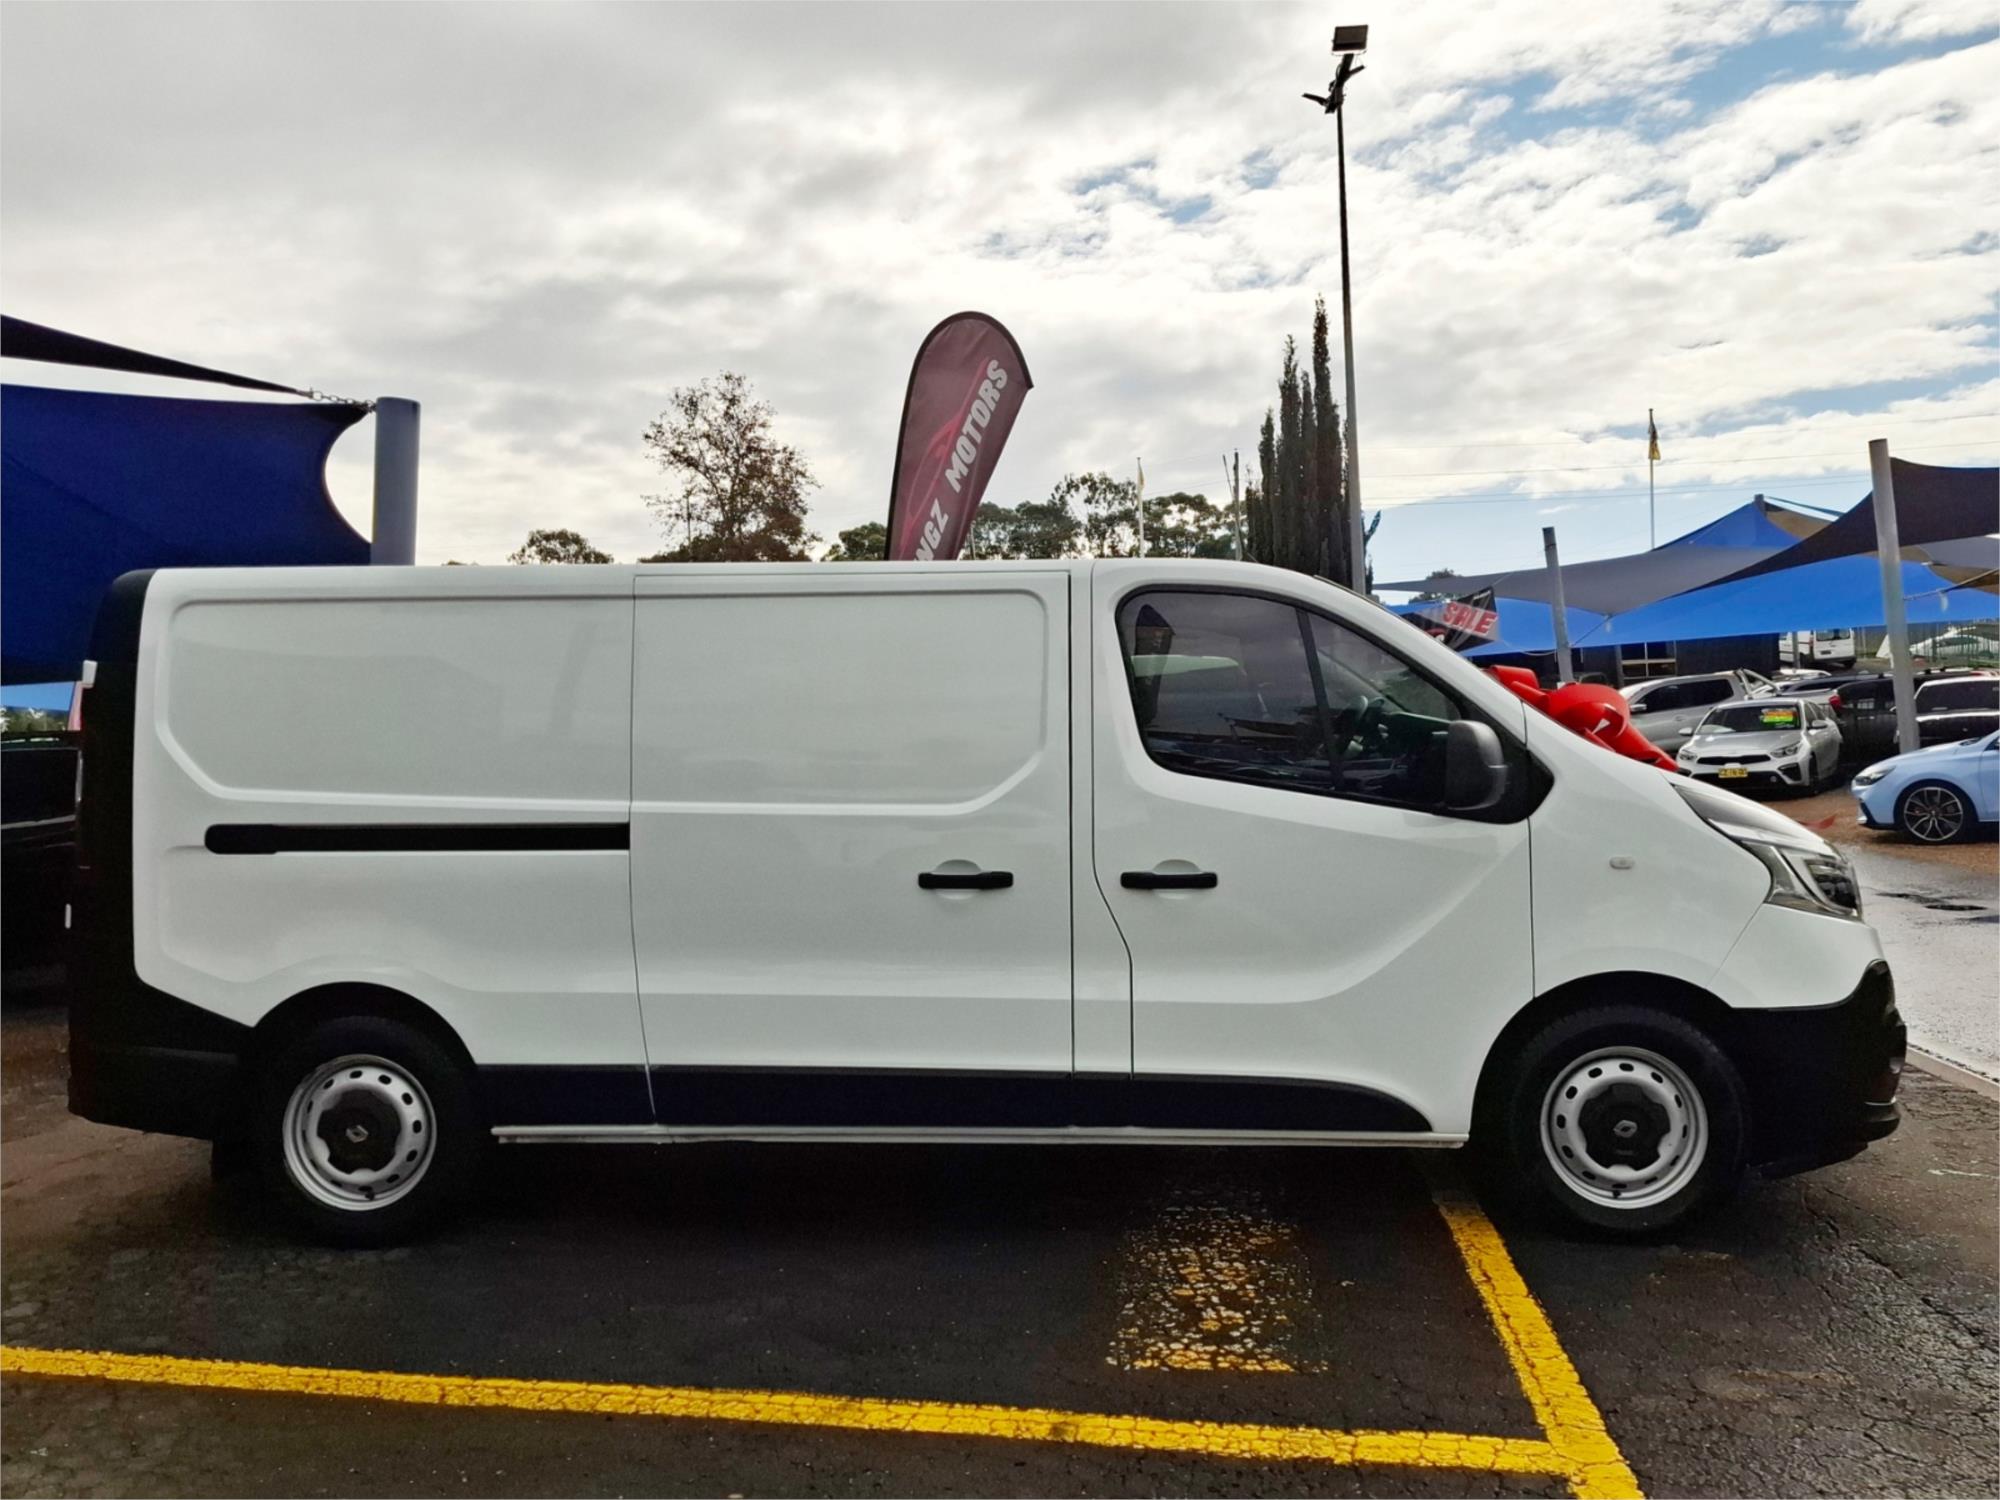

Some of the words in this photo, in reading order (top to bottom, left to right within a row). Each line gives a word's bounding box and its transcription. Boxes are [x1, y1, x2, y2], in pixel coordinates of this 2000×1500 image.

[913, 497, 949, 561] NGZ
[945, 359, 1008, 493] MOTORS
[1443, 601, 1498, 636] SALE
